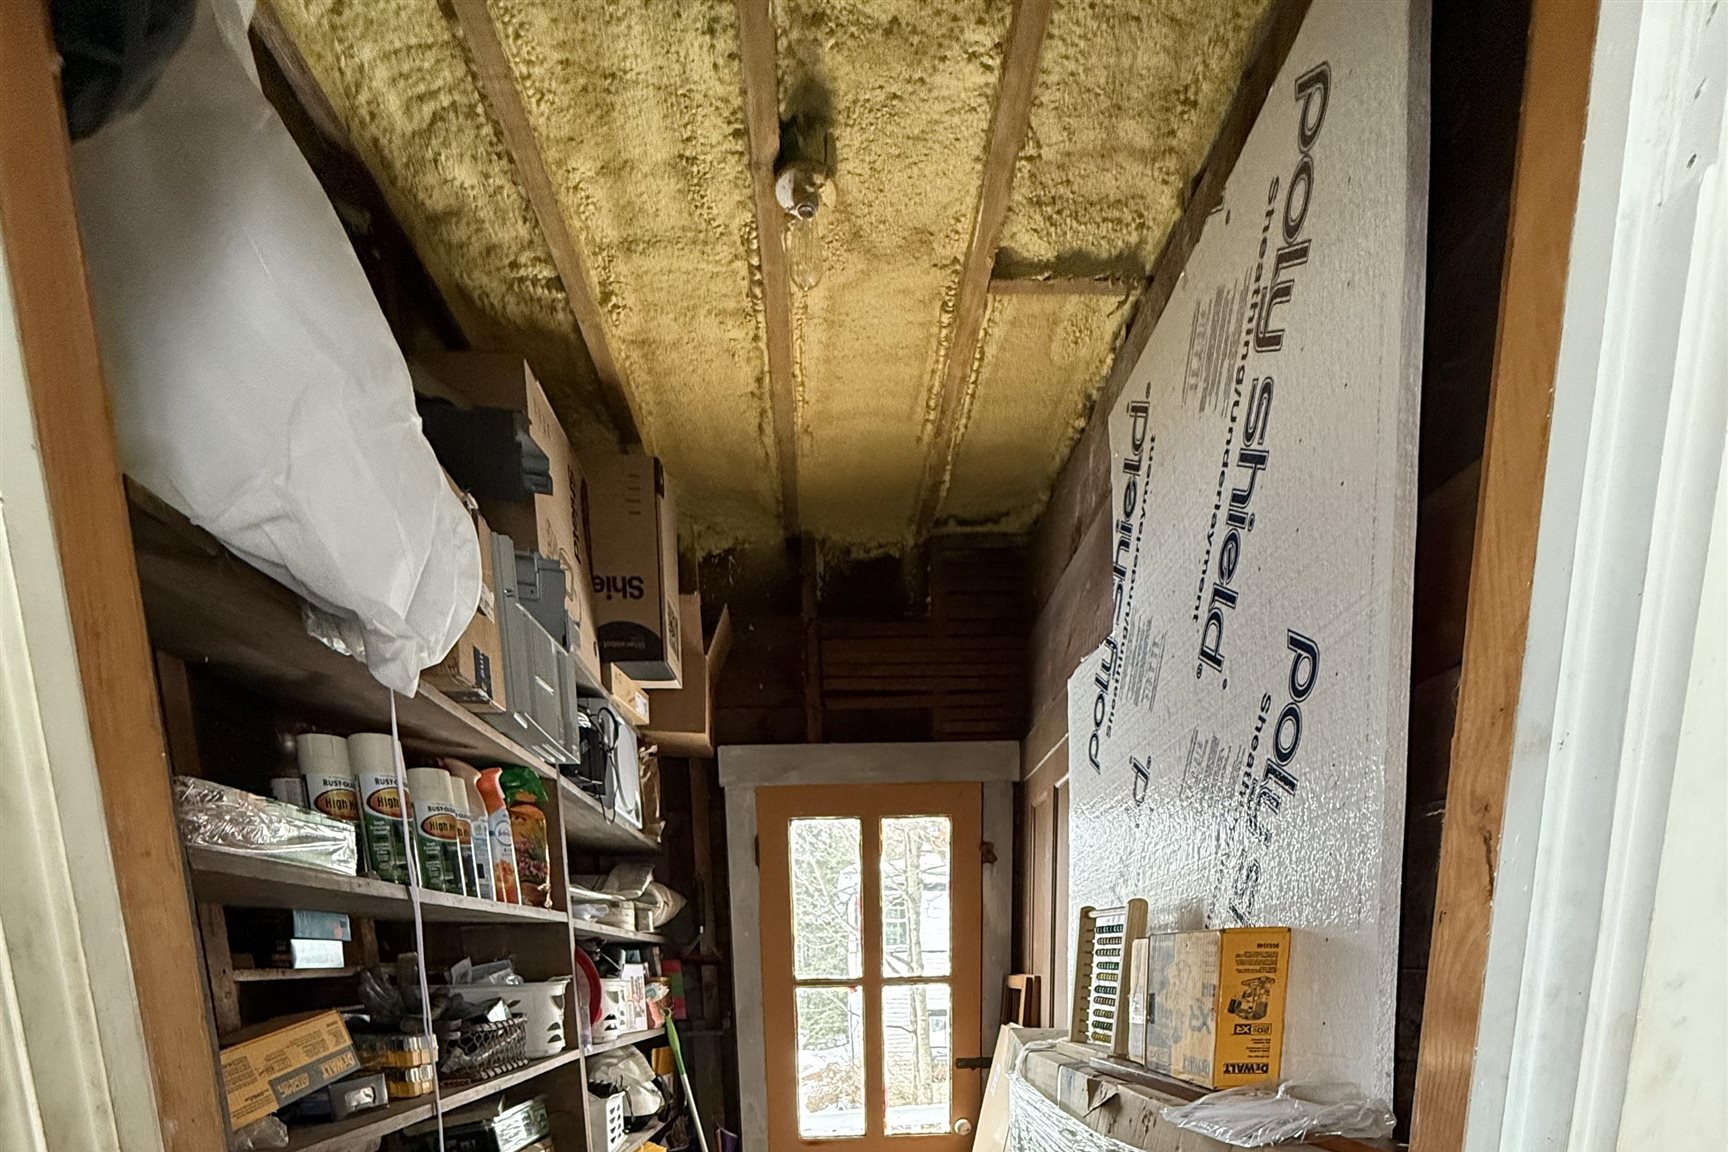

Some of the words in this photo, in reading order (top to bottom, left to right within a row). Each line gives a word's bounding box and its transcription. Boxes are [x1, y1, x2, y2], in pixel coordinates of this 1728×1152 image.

[592, 574, 645, 601] Shie
[325, 796, 348, 811] High
[377, 796, 401, 809] High
